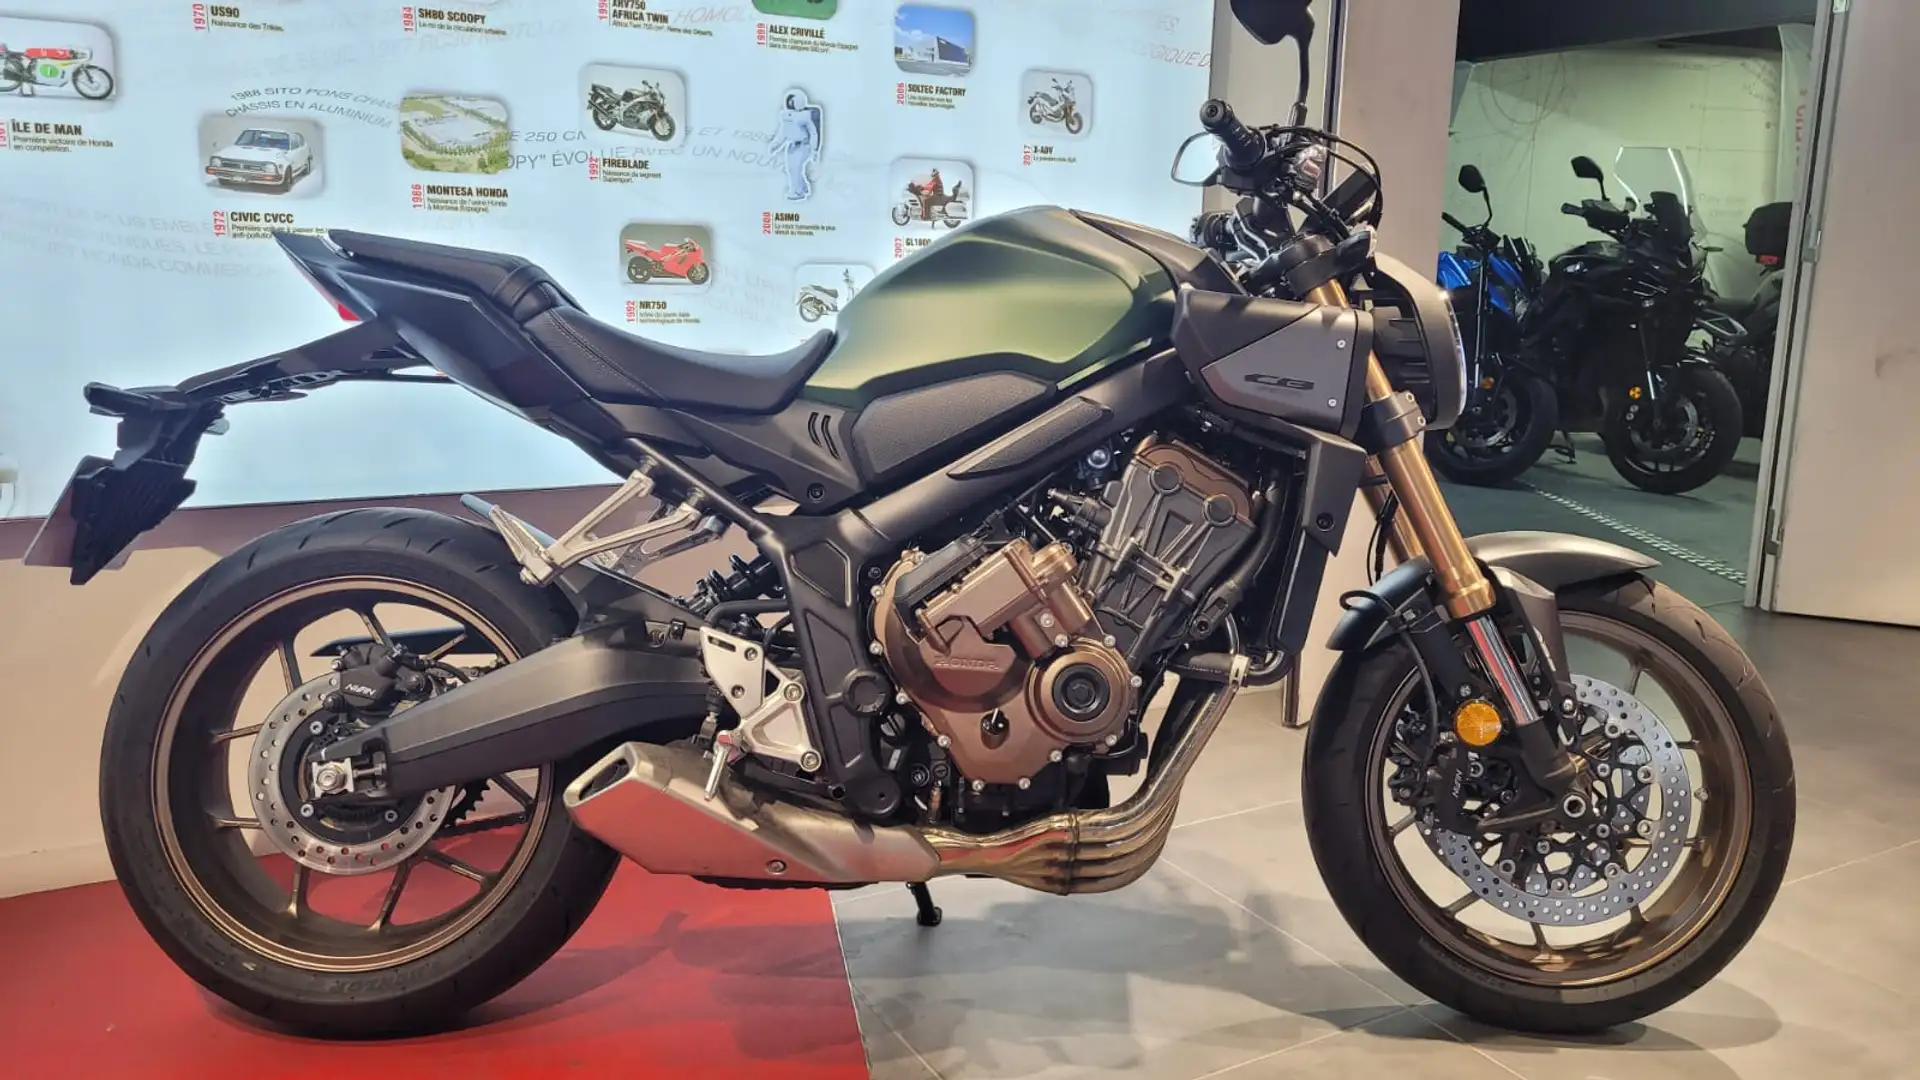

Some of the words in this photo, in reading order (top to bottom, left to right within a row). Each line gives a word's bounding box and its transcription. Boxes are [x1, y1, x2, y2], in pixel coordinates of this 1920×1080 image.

[192, 3, 206, 31] 1970
[210, 5, 240, 18] US90
[402, 6, 414, 32] 1984
[418, 8, 445, 20] SH80
[447, 11, 486, 24] SCOOPY
[612, 9, 645, 21] AFRICA
[646, 12, 669, 24] TWIN
[211, 19, 248, 29] Naissance
[248, 22, 261, 30] des
[768, 24, 788, 35] ALEX
[264, 87, 301, 96] SITO
[304, 88, 353, 100] PONS
[935, 86, 967, 97] FACTORY
[284, 100, 305, 109] EN
[308, 102, 393, 128] ALUMINIUM
[11, 118, 31, 133] ÎLE
[33, 121, 51, 135] DE
[54, 123, 83, 136] MAN
[13, 134, 47, 144] Première
[77, 138, 87, 147] de
[88, 139, 114, 149] Honda
[523, 130, 556, 142] 250
[13, 144, 25, 152] en
[691, 144, 722, 158] UN
[588, 156, 599, 181] 1992
[602, 158, 650, 170] FIREBLADE
[411, 184, 423, 209] 1986
[426, 184, 473, 197] MONTESA
[475, 188, 509, 199] HONDA
[212, 210, 226, 237] 1972
[230, 211, 261, 222] CIVIC
[264, 212, 295, 224] CVCC
[774, 212, 800, 222] ASIMO
[625, 300, 636, 322] 1992
[639, 301, 667, 310] NR750
[933, 655, 1001, 671] HONDA
